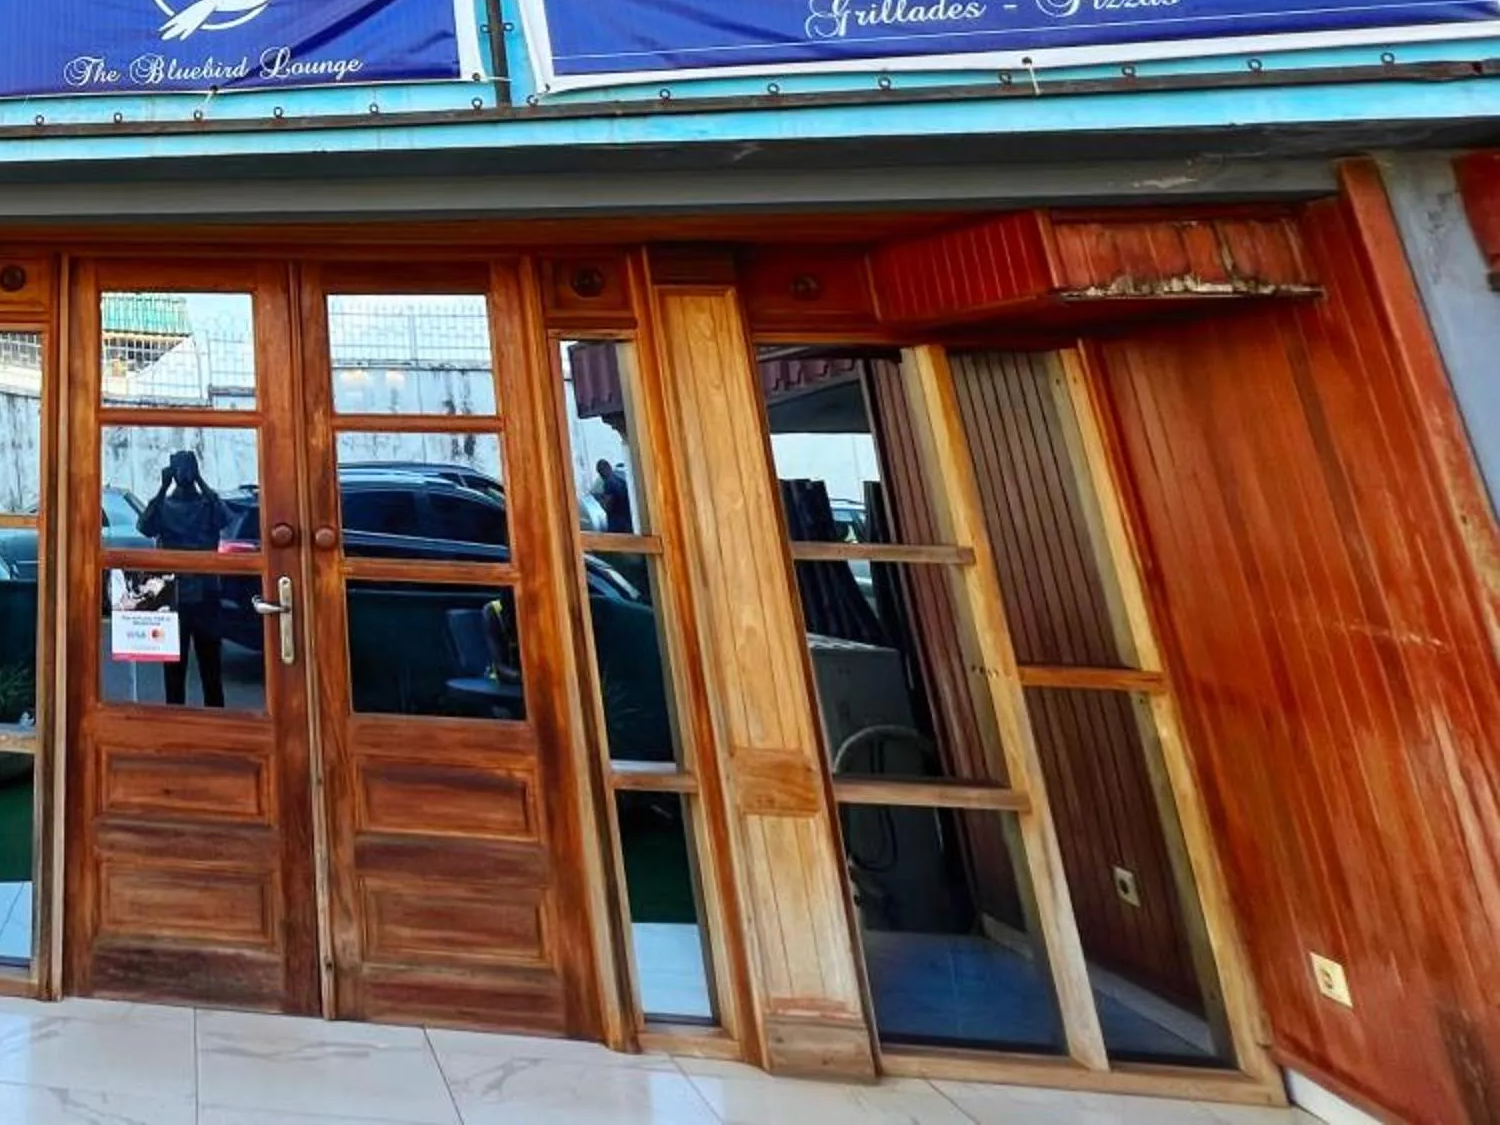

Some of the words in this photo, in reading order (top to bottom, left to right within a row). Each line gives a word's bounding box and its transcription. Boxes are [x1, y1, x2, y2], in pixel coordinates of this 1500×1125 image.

[63, 55, 121, 87] The
[128, 52, 250, 85] Bluebird
[258, 46, 364, 81] Lounge
